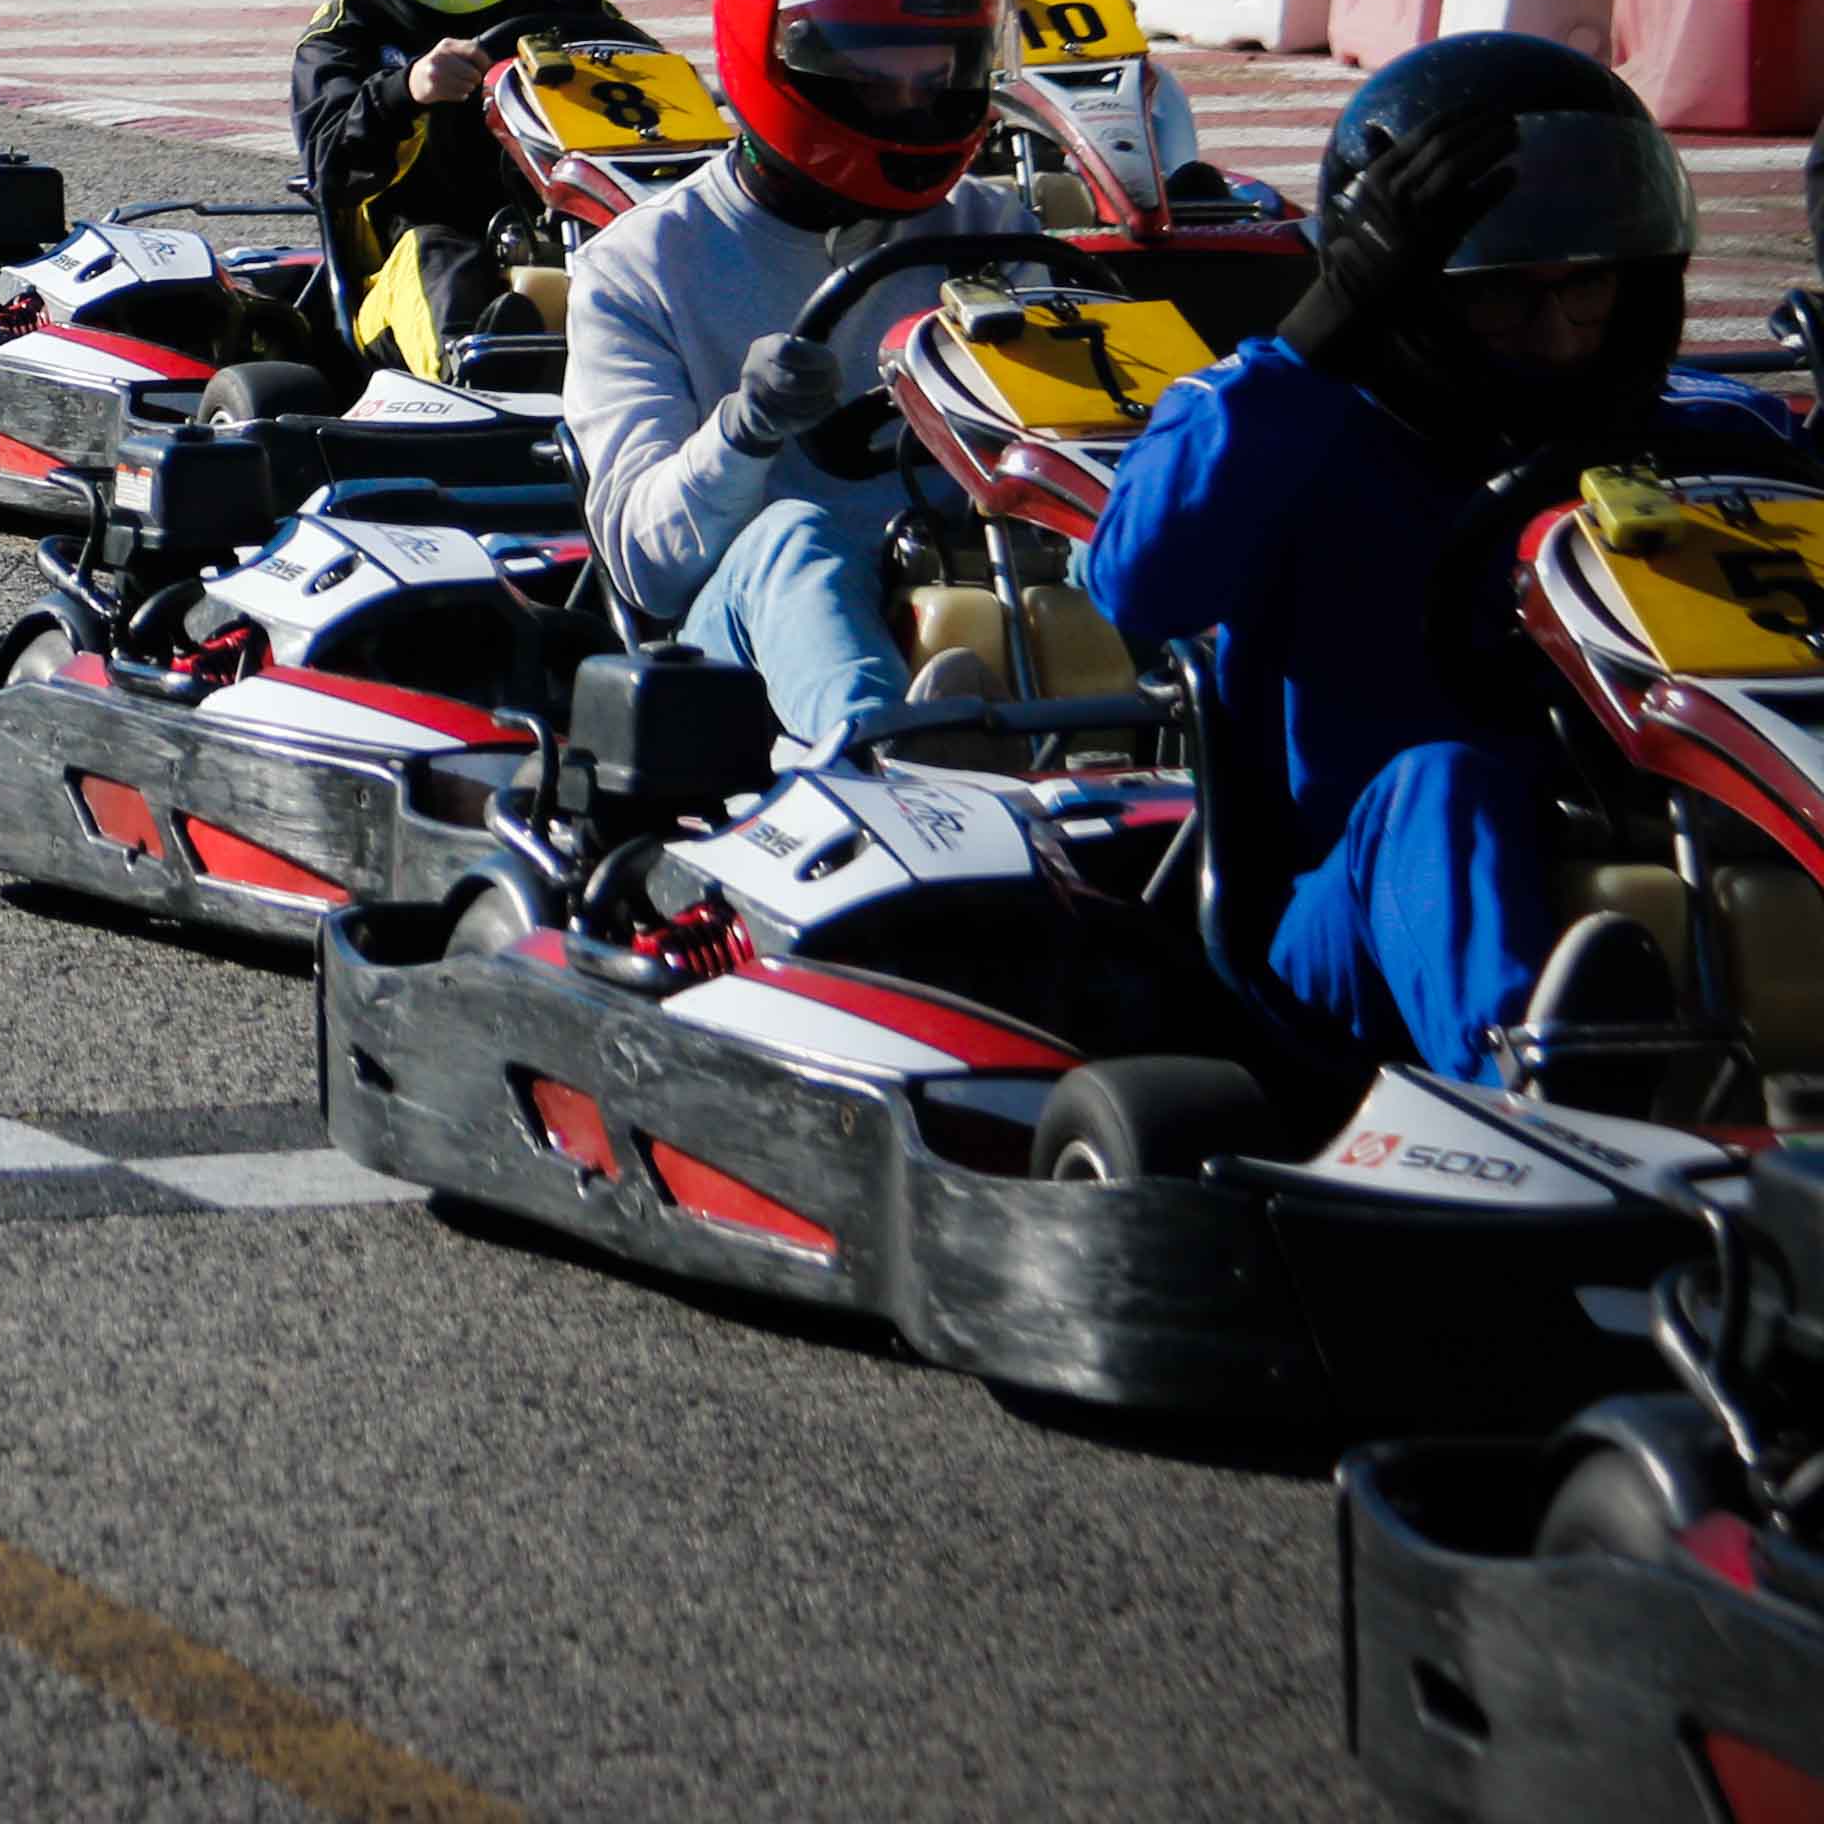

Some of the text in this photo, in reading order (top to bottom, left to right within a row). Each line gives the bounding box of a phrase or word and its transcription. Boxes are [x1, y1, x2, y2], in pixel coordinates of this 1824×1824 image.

[591, 79, 662, 131] 8
[1046, 324, 1134, 410] 7
[383, 401, 455, 418] SODI
[1398, 1144, 1532, 1188] SODI
